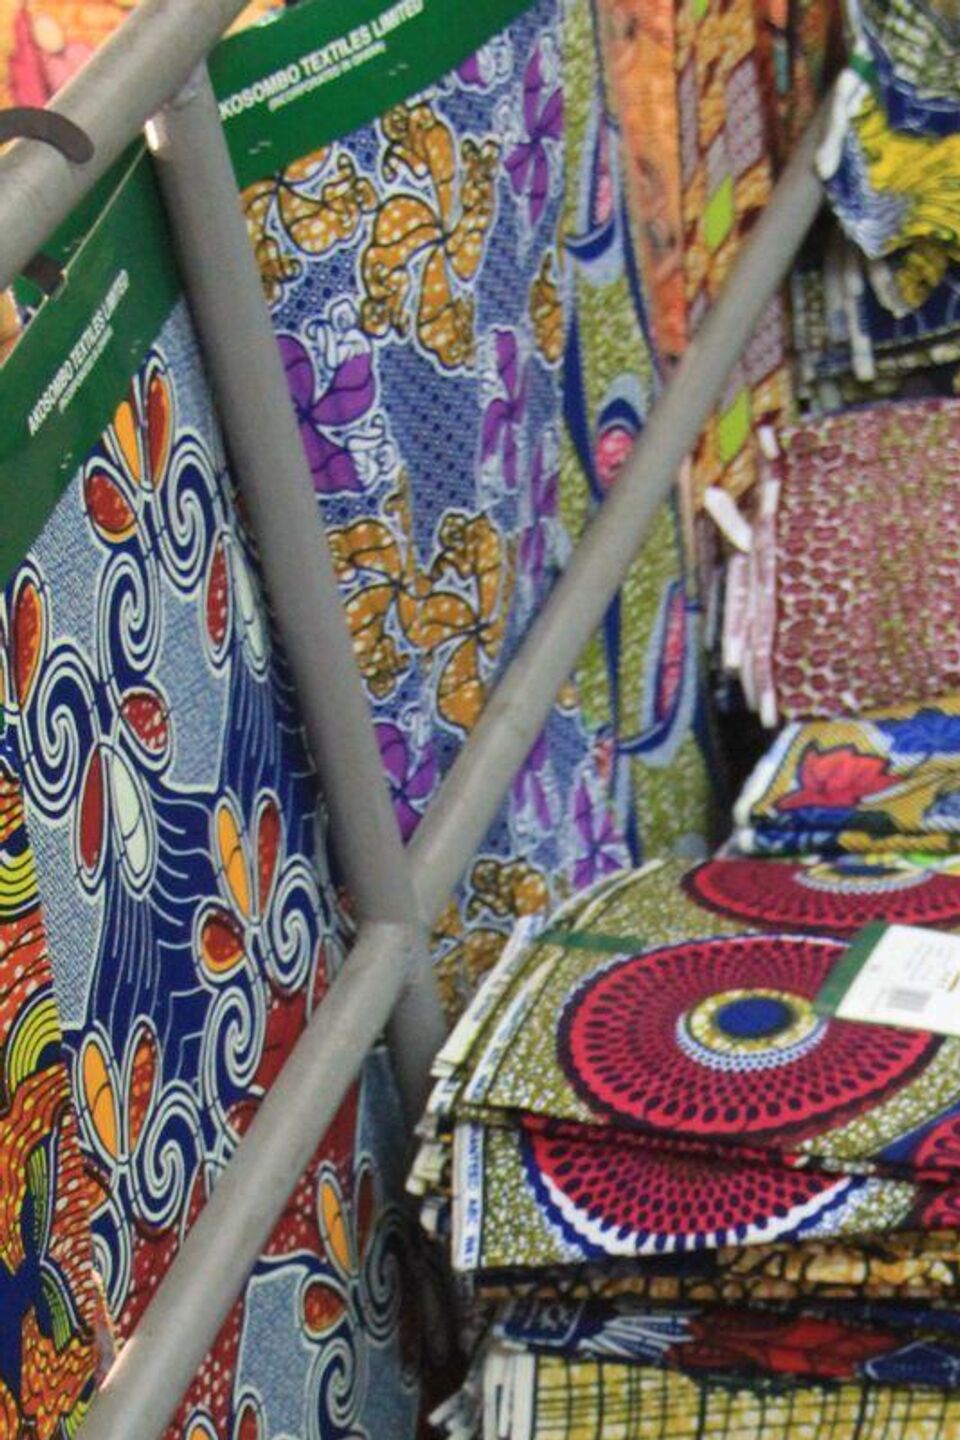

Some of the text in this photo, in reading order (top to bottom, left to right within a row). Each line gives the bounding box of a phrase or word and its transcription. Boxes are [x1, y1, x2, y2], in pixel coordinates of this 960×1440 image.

[218, 0, 424, 120] KOSOMBO TEXTILES LIMITED
[27, 360, 74, 436] AKOSOMBO
[69, 309, 106, 369] TEXTILES
